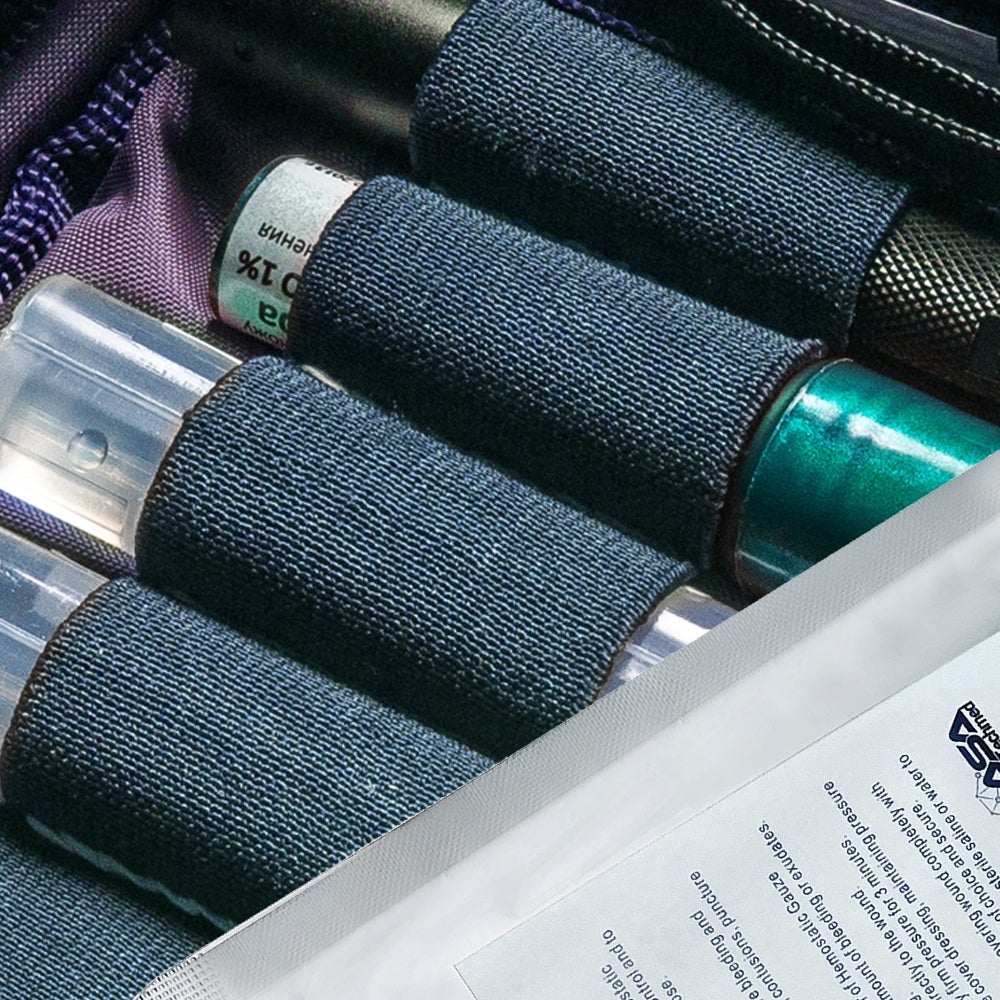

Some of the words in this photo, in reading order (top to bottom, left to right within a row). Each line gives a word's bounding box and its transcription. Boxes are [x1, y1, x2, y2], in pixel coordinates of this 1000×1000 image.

[236, 250, 277, 285] 1%
[898, 753, 913, 770] to
[870, 780, 895, 810] with
[906, 766, 938, 802] water
[822, 779, 870, 836] pressure
[911, 798, 947, 845] secure.
[931, 799, 949, 815] or
[757, 819, 803, 881] exudates.
[888, 806, 943, 872] completely
[943, 813, 977, 852] saline
[840, 833, 881, 889] minutes.
[860, 832, 918, 905] maintaining
[938, 842, 965, 869] and
[689, 870, 737, 928] puncture
[767, 870, 801, 915] Gauze
[796, 880, 814, 896] or
[872, 886, 888, 899] 3
[933, 869, 973, 913] wound
[960, 866, 995, 909] choice
[688, 909, 715, 936] and
[807, 893, 852, 951] bleeding
[849, 884, 888, 932] wound.
[881, 896, 902, 917] for
[601, 928, 617, 946] to
[796, 911, 852, 985] Hemostatic
[882, 928, 904, 953] the
[896, 913, 945, 969] pressure
[914, 900, 960, 960] dressing,
[607, 942, 635, 970] and
[709, 933, 754, 993] bleeding
[730, 925, 783, 999] contusions,
[842, 947, 862, 962] of
[898, 949, 914, 967] to
[841, 980, 862, 996] of
[935, 966, 960, 996] firm
[952, 959, 986, 995] cover
